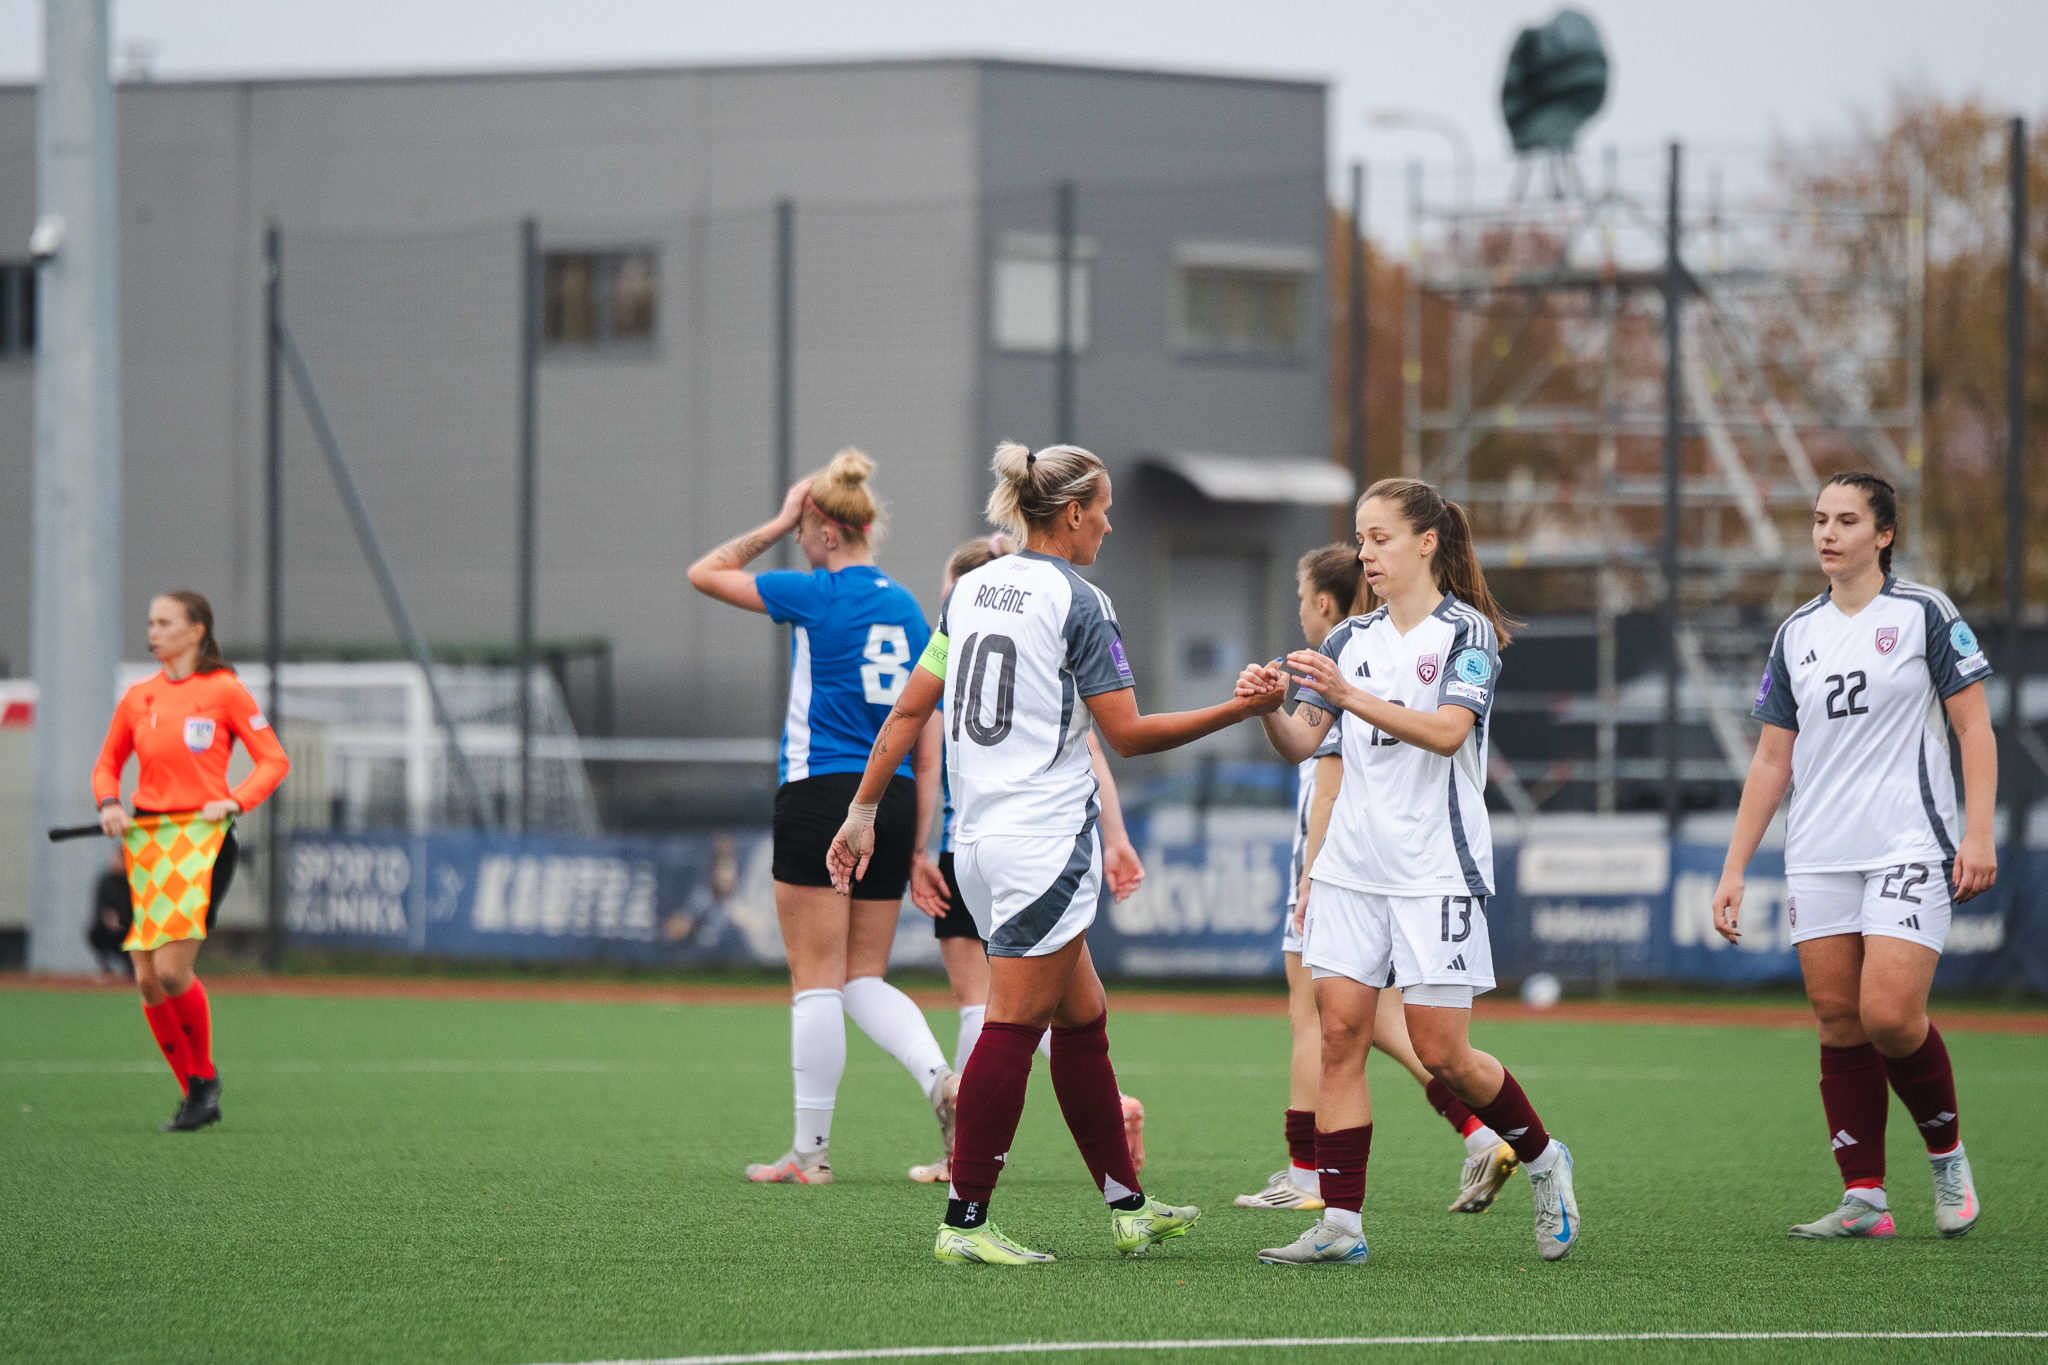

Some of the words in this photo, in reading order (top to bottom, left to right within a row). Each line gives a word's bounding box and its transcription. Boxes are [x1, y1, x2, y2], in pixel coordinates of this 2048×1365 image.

[974, 583, 1032, 614] ROČĀNE
[860, 623, 911, 706] 8
[952, 631, 1017, 747] 10
[1825, 670, 1868, 719] 22
[1880, 863, 1929, 905] 22
[1441, 896, 1472, 942] 13
